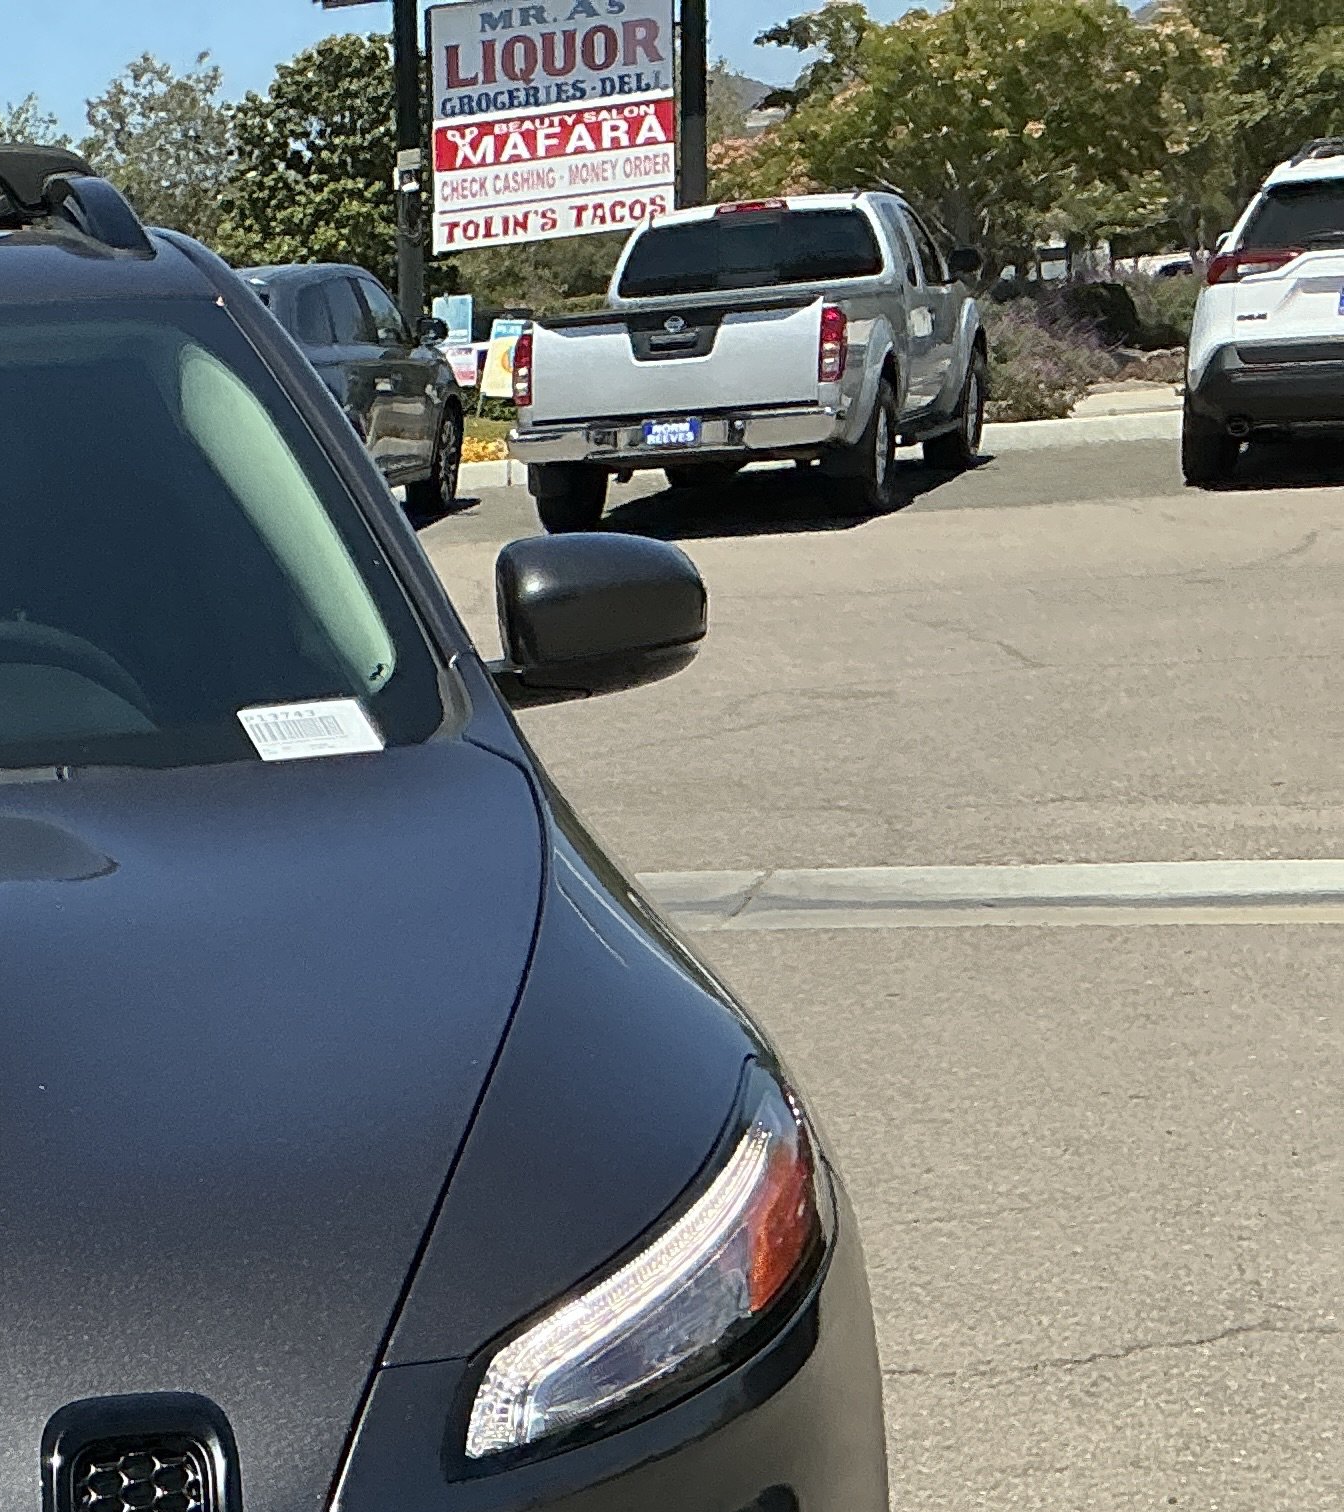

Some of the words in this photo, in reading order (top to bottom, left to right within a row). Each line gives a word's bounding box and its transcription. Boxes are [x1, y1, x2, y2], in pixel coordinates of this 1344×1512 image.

[480, 5, 558, 33] MR.
[444, 17, 665, 90] LIQUOR
[440, 79, 587, 118] GROCERIES
[493, 113, 578, 135] BEAUTY
[583, 103, 656, 123] SALON
[450, 114, 667, 168] MAFARA
[440, 176, 490, 203] CHECK
[493, 166, 557, 194] CASHING
[567, 158, 620, 186] MONEY
[622, 152, 672, 179] ORDER
[440, 207, 558, 245] TOLIN'S
[567, 193, 666, 228] TACOS
